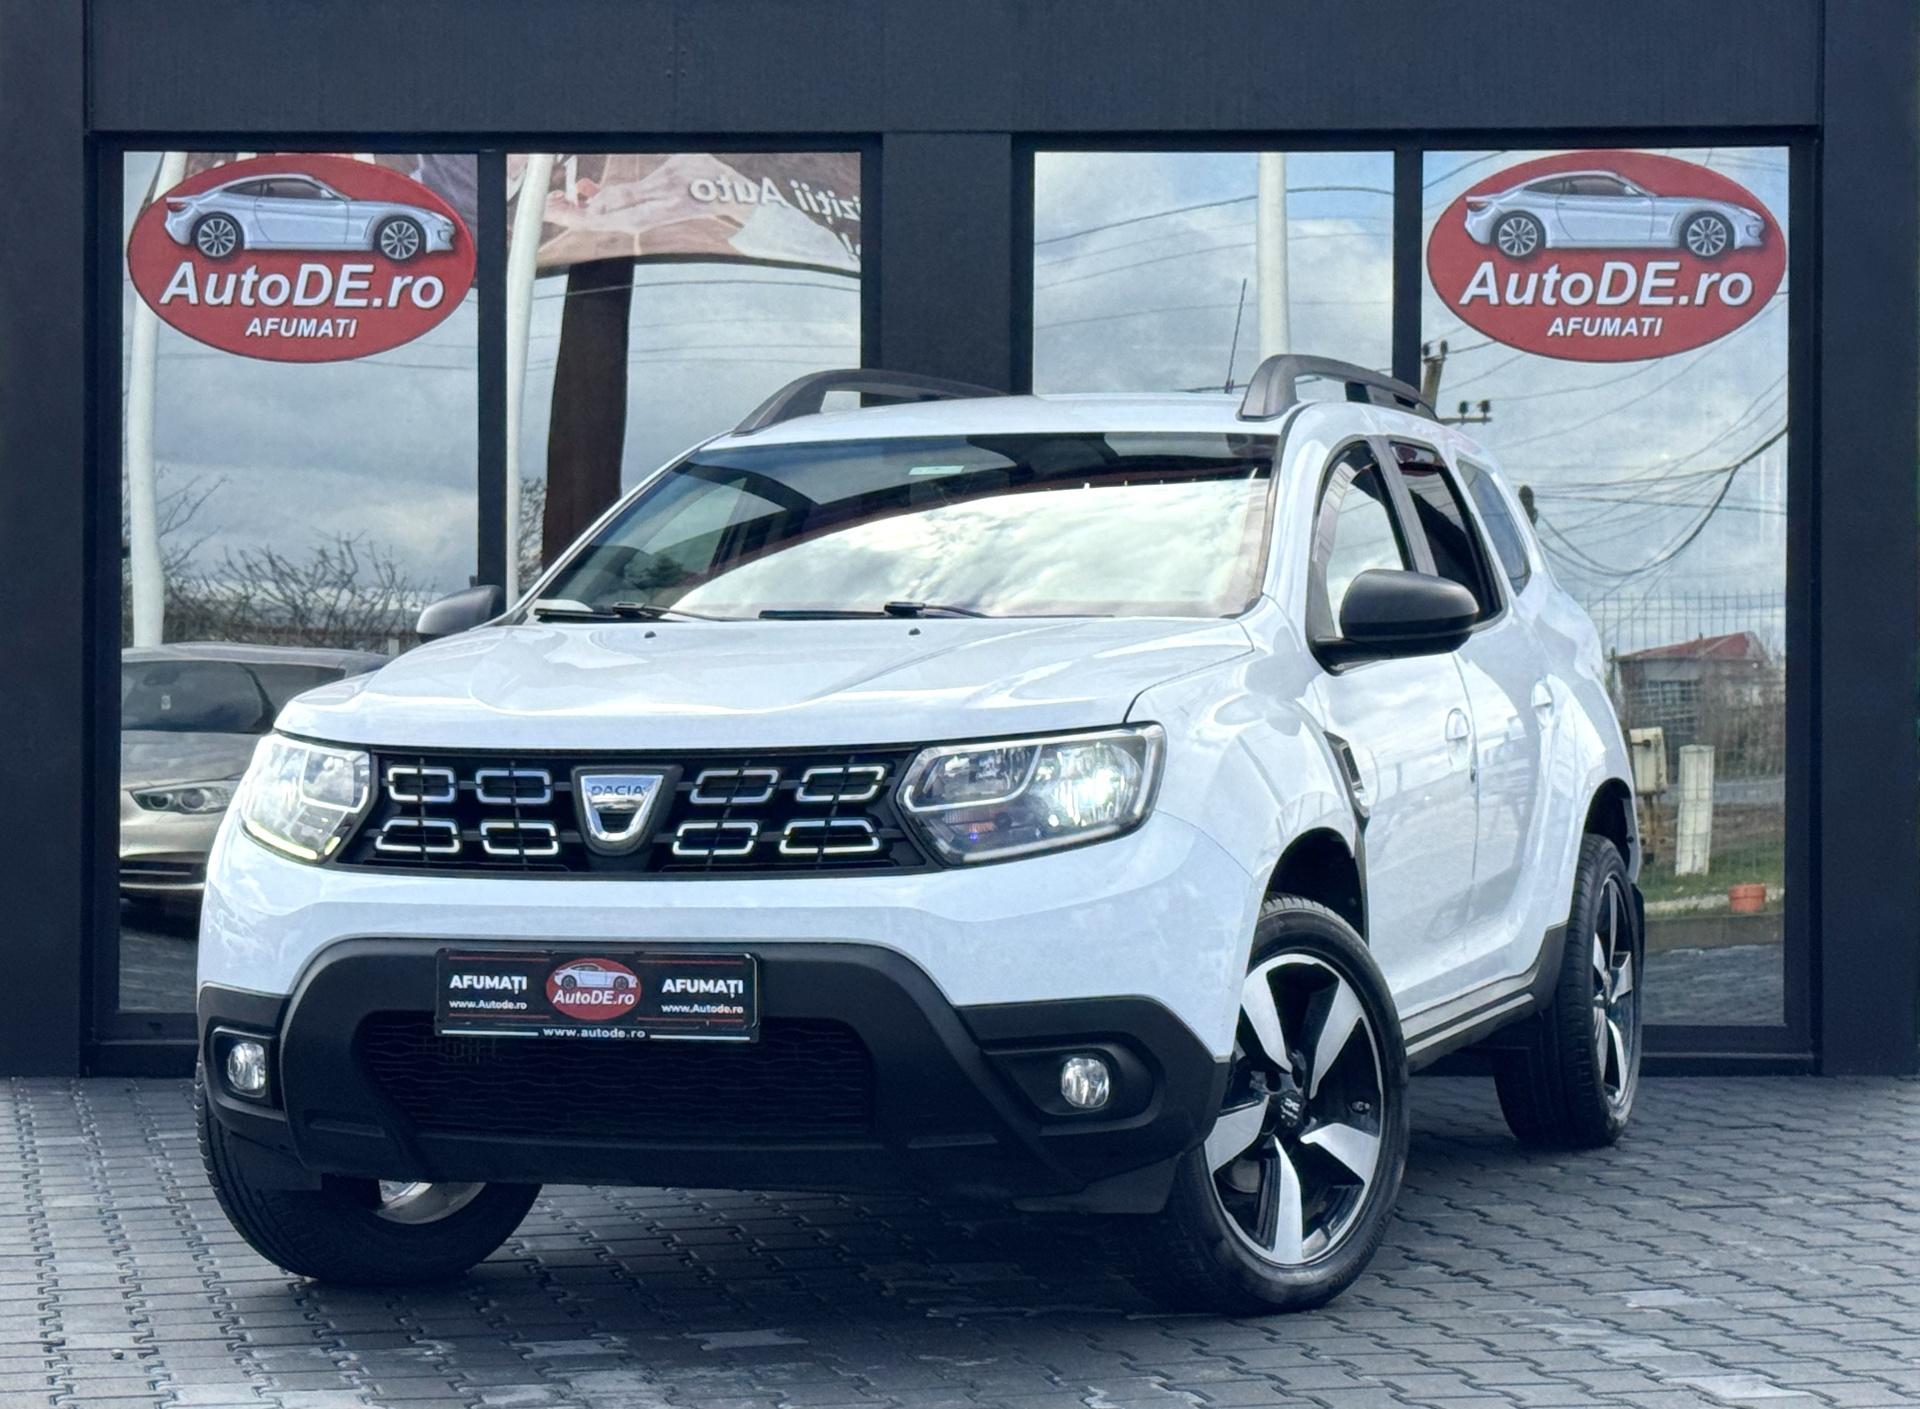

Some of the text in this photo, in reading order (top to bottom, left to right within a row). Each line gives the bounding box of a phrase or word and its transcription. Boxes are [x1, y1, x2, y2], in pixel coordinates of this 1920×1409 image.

[159, 261, 445, 309] AutoDE.ro
[1459, 261, 1753, 307] AutoDE.ro
[245, 317, 358, 338] AFUMATI
[1547, 317, 1663, 337] AFUMATI
[591, 785, 644, 796] DACIA
[449, 974, 528, 995] AFUMAȚI
[661, 978, 744, 999] AFUMAȚI
[449, 999, 528, 1010] www.Autode.ro
[552, 989, 635, 1005] AutoDE.ro
[660, 1003, 744, 1015] www.Autode.ro
[542, 1027, 646, 1038] www.autode.ro
